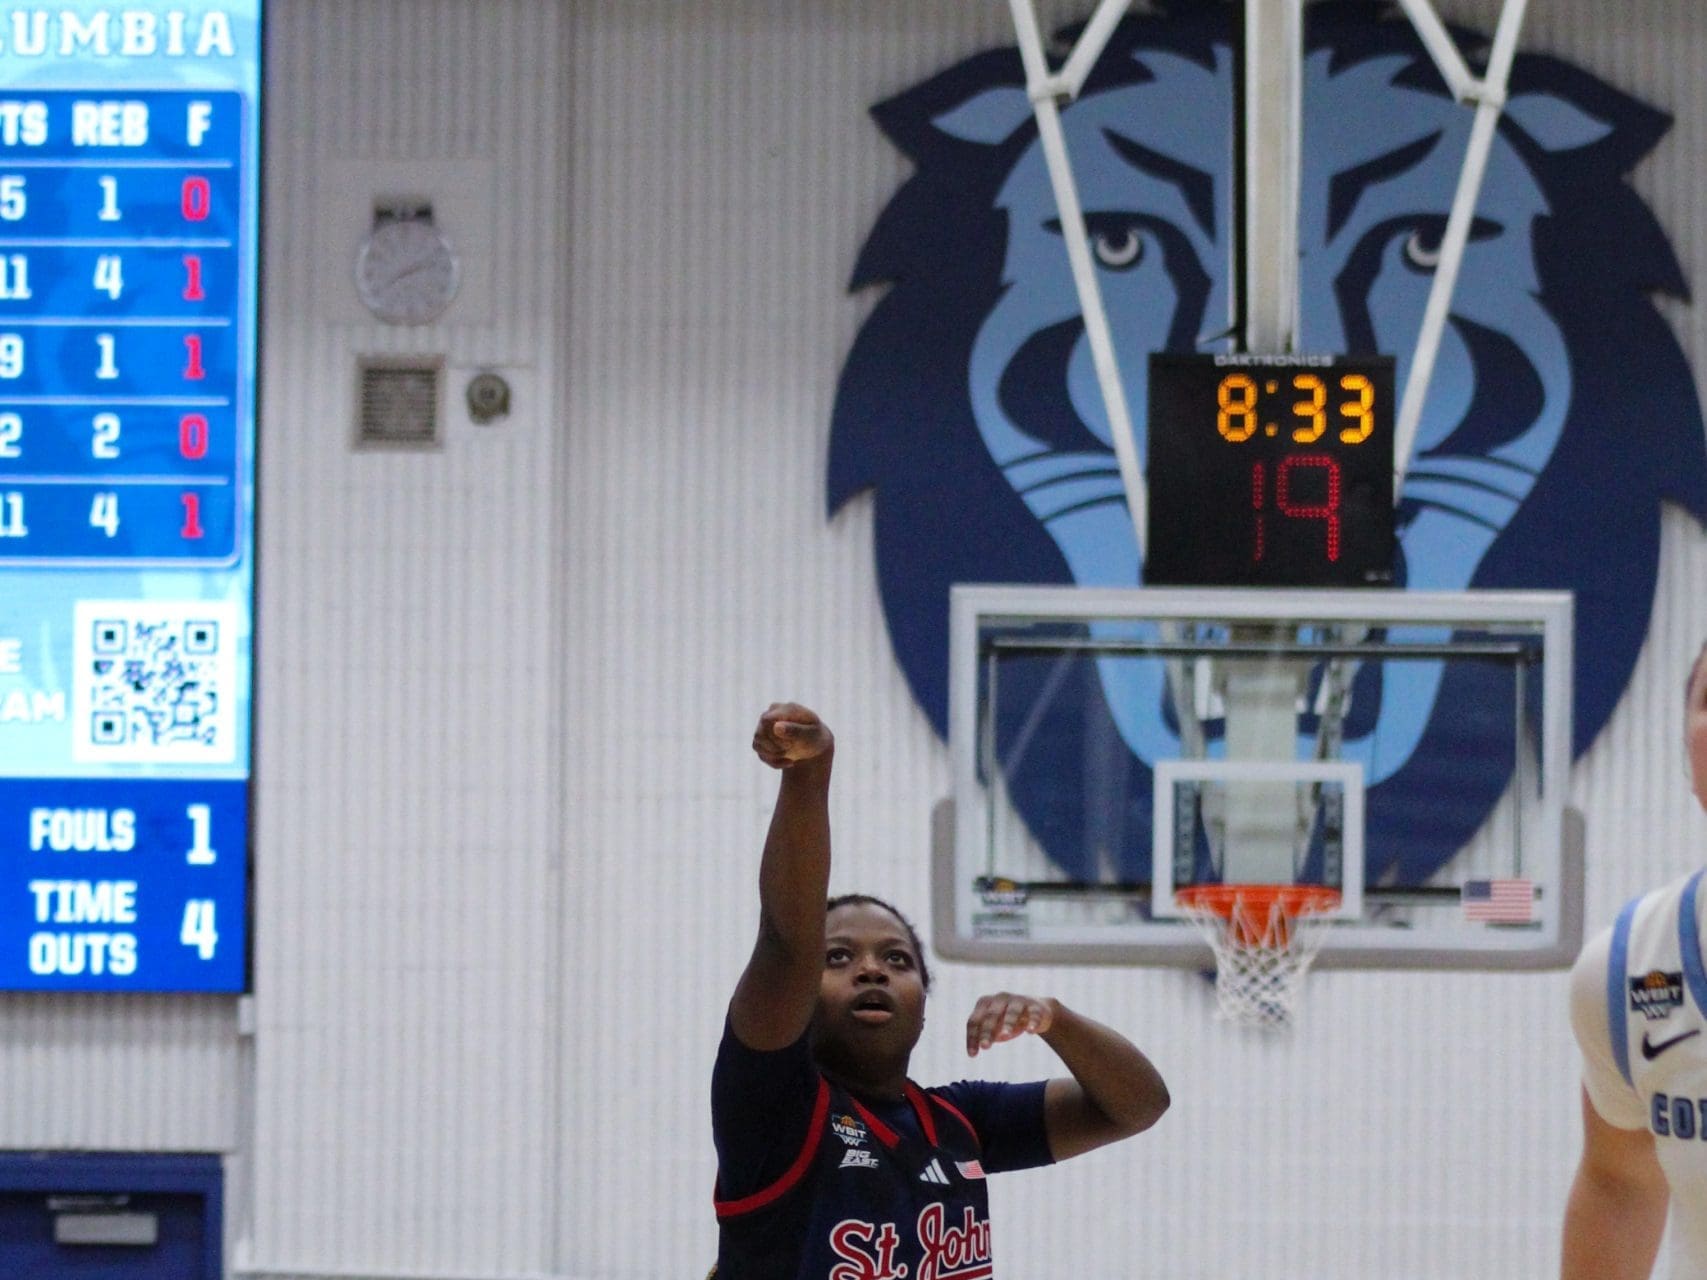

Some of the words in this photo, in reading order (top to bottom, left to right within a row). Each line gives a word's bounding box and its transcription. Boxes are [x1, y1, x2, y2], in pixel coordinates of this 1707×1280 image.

[0, 11, 235, 56] UMBIA
[0, 101, 48, 146] TS
[72, 101, 149, 146] REB
[187, 103, 212, 146] F
[98, 176, 121, 221] 1
[181, 176, 210, 221] 0
[93, 254, 123, 299] 4
[183, 255, 205, 299] 1
[96, 334, 119, 379] 1
[183, 334, 205, 379] 1
[1217, 373, 1375, 444] 8:33
[92, 413, 121, 459] 2
[179, 414, 208, 459] 0
[89, 493, 120, 537] 4
[181, 493, 204, 538] 1
[1252, 455, 1341, 562] 19
[30, 808, 136, 851] FOULS
[186, 804, 216, 865] 1
[28, 880, 137, 923] TIME
[181, 900, 218, 960] 4
[28, 932, 137, 975] OUTS
[832, 1122, 867, 1139] WBIT
